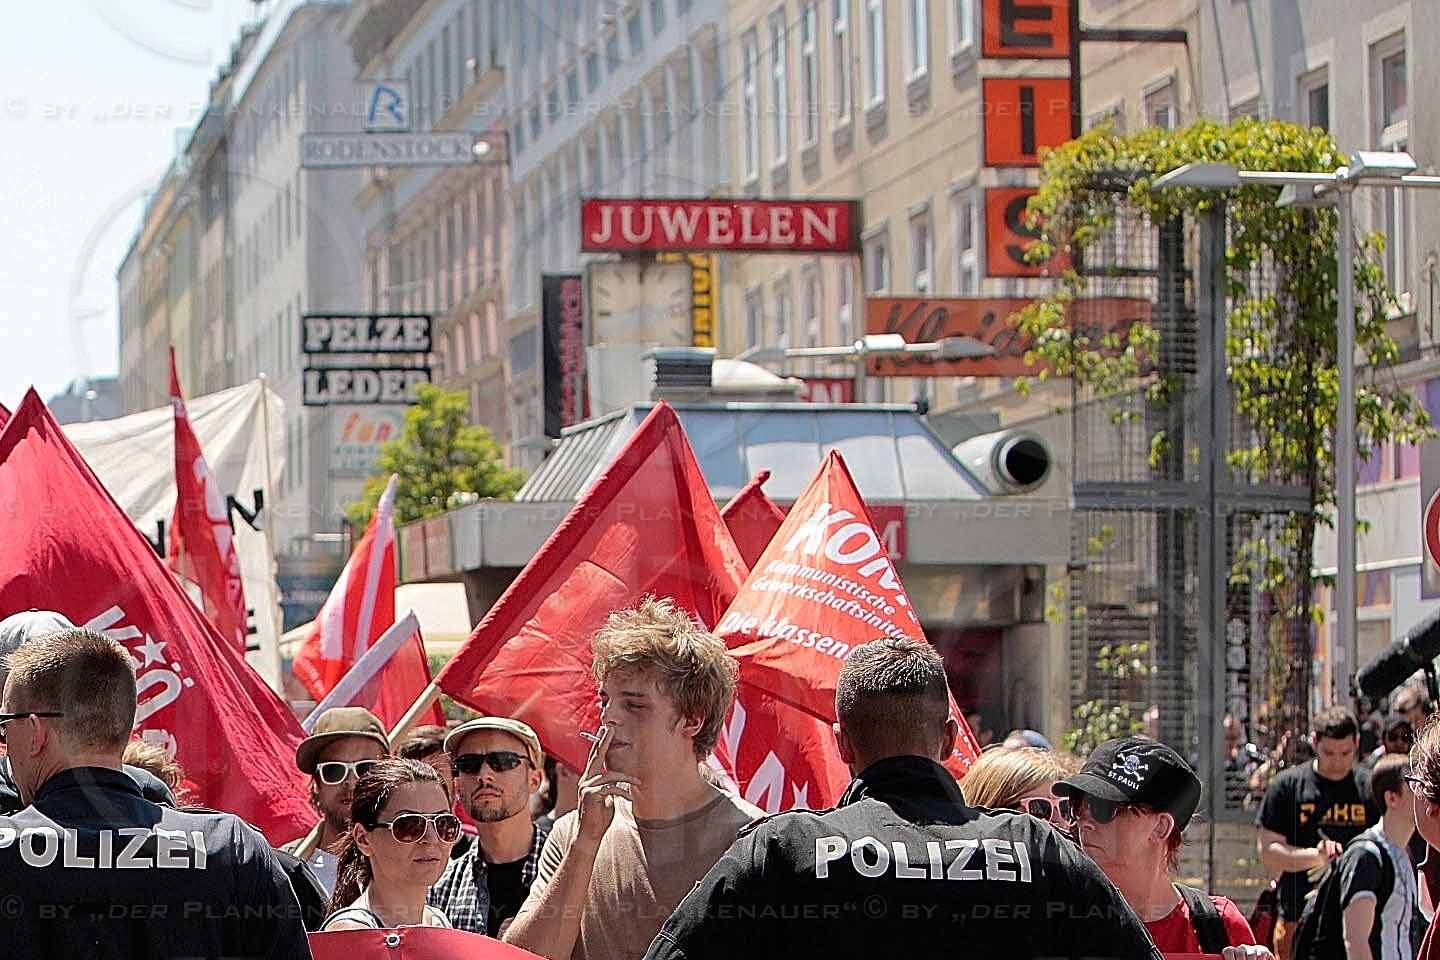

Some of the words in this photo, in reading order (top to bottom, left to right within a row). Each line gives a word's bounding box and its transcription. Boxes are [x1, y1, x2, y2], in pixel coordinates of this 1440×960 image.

[591, 205, 840, 244] JUWELEN
[305, 317, 429, 350] PELZE
[751, 575, 909, 640] Gewerkschaftsiniti
[764, 559, 896, 616] Kommunistische
[815, 835, 1033, 883] POLIZEI
